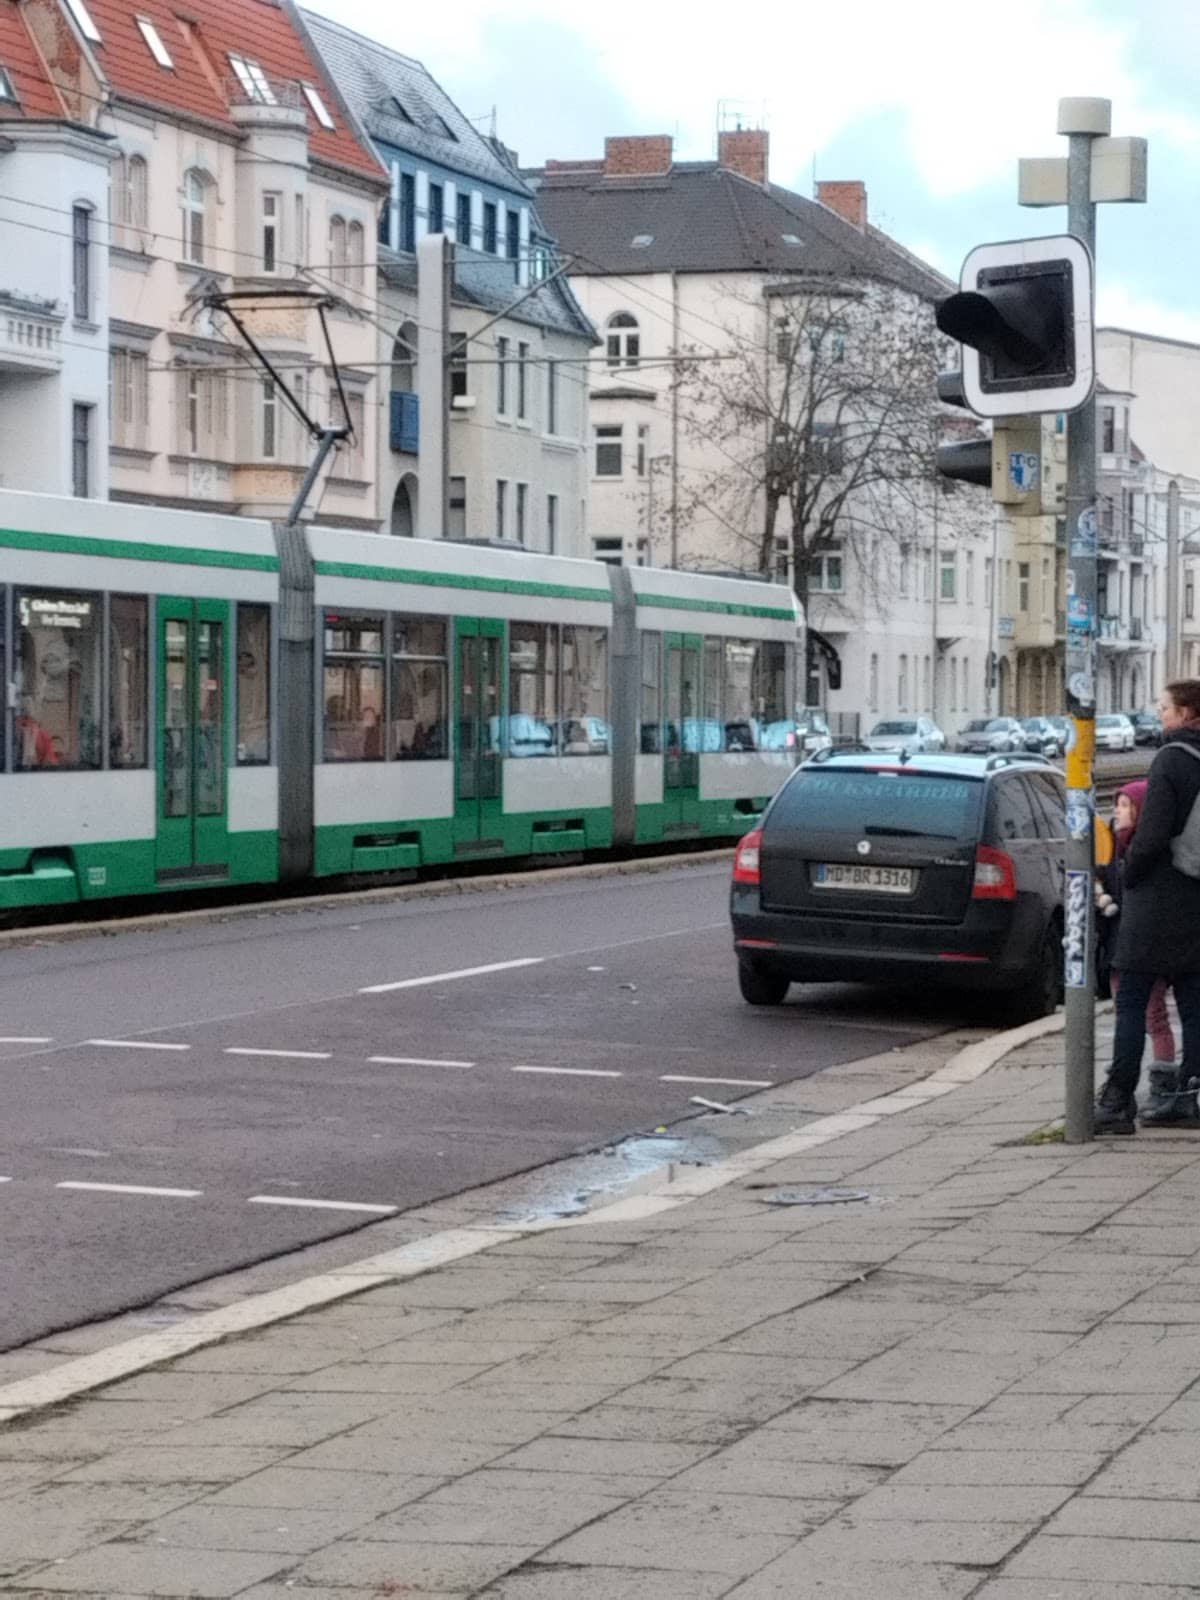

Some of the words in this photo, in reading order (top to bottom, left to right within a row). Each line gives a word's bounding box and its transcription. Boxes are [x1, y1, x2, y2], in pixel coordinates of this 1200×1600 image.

[826, 865, 844, 882] MD
[853, 867, 871, 884] BR
[875, 869, 909, 887] 1316
